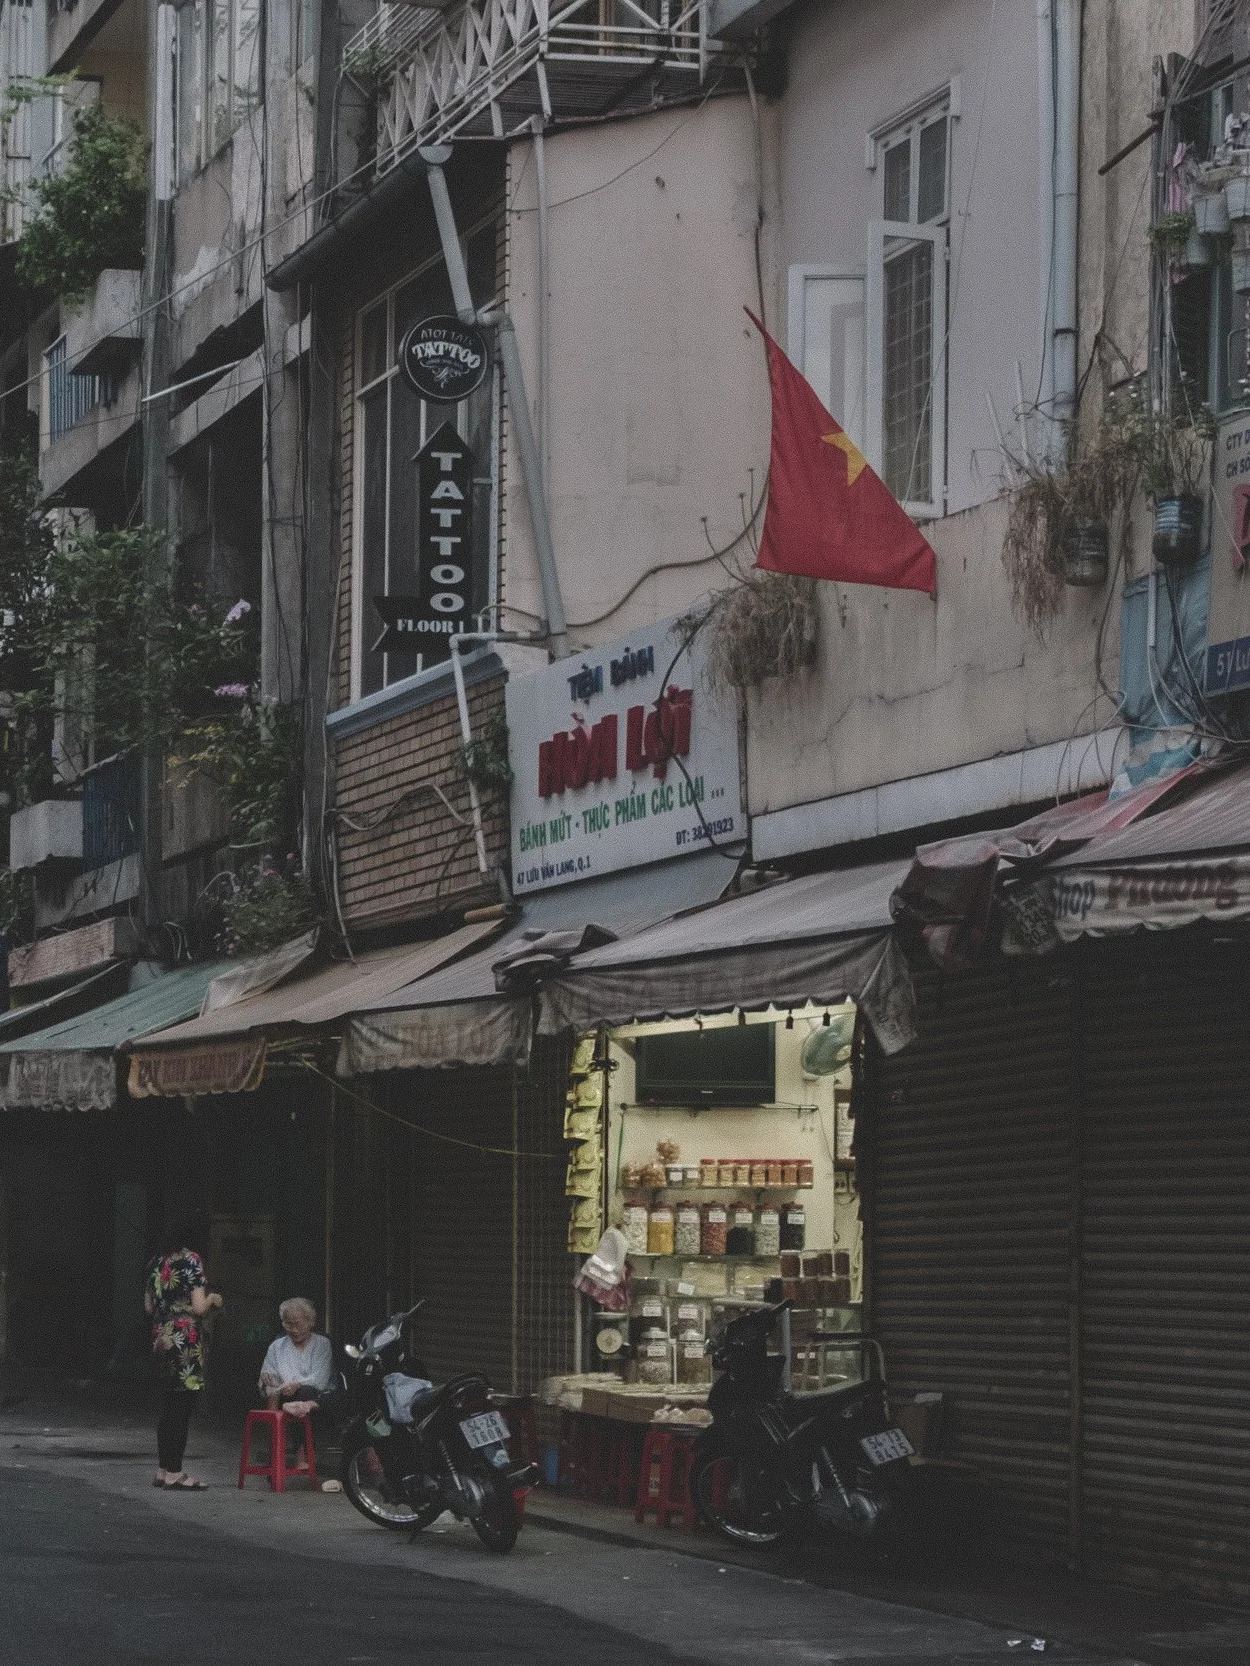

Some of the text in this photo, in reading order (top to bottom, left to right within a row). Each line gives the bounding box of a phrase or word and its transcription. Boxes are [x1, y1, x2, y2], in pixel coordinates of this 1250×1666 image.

[410, 340, 481, 368] TATTOO
[429, 452, 466, 613] TATTOO
[396, 618, 454, 635] FLOOR
